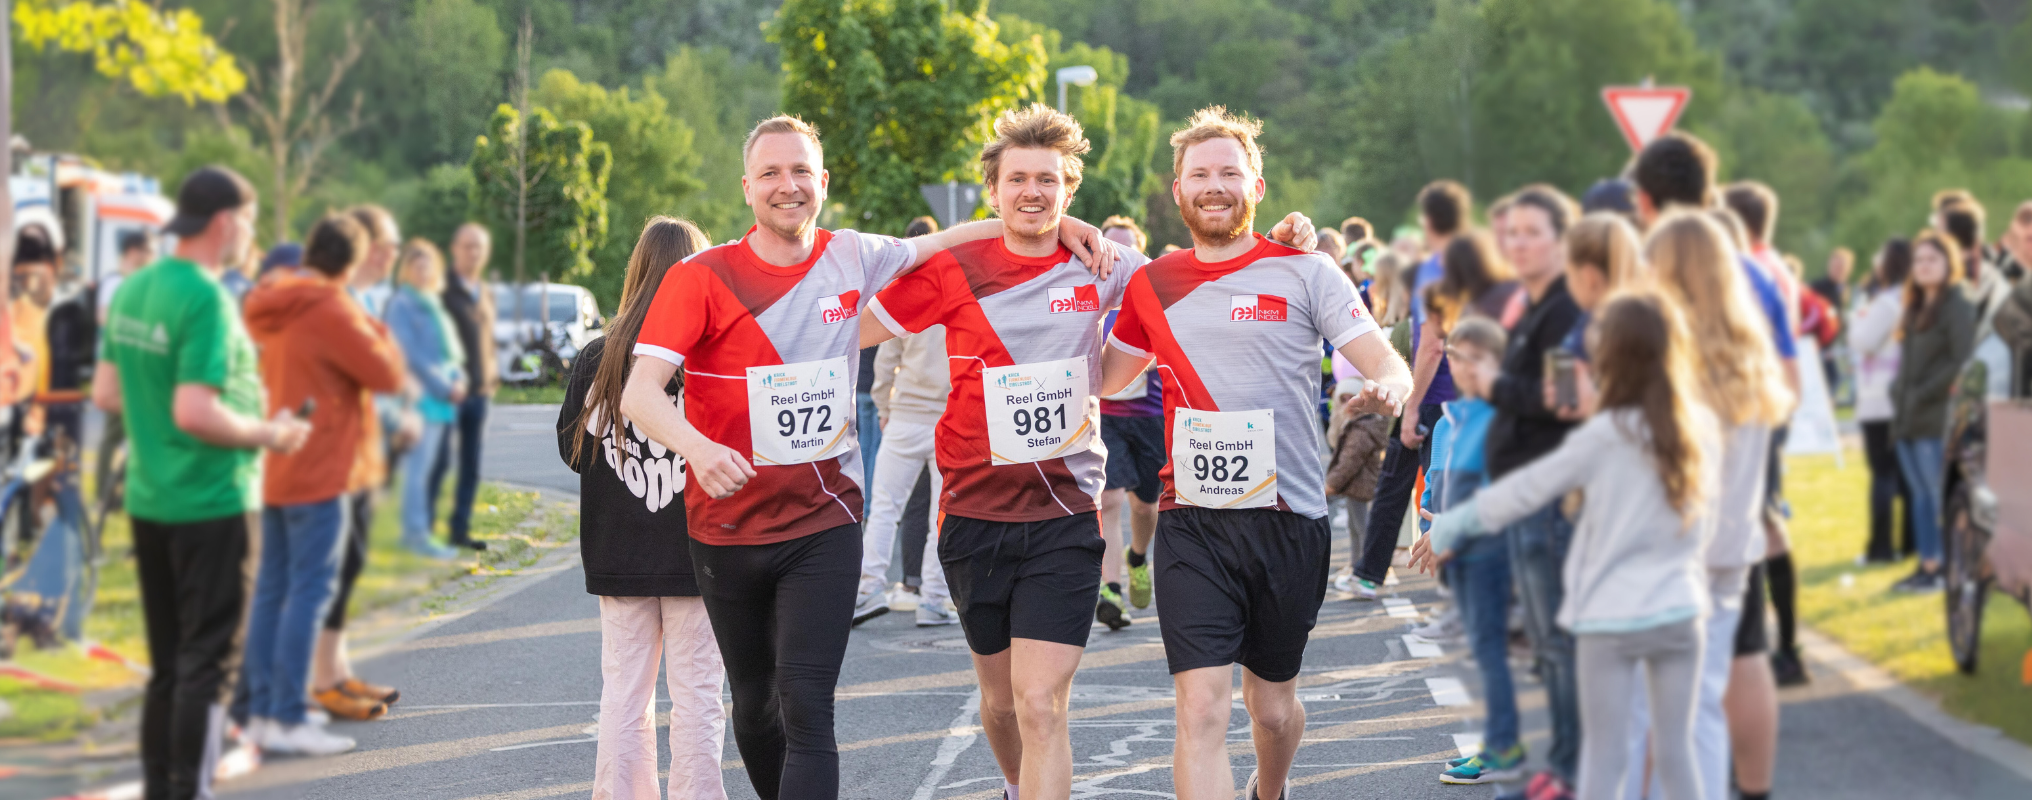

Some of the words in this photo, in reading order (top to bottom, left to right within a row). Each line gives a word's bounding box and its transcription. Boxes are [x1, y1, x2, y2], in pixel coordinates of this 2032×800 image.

[771, 393, 797, 406] Reel
[801, 388, 835, 402] GmbH
[1006, 393, 1033, 405] Reel
[1036, 387, 1072, 402] GmbH
[777, 404, 832, 437] 972
[1013, 403, 1066, 436] 981
[791, 437, 824, 449] Martin
[1027, 435, 1061, 448] Stefan
[1189, 438, 1212, 450] Reel
[1215, 440, 1253, 451] GmbH
[1193, 454, 1249, 482] 982
[1199, 484, 1244, 495] Andreas
